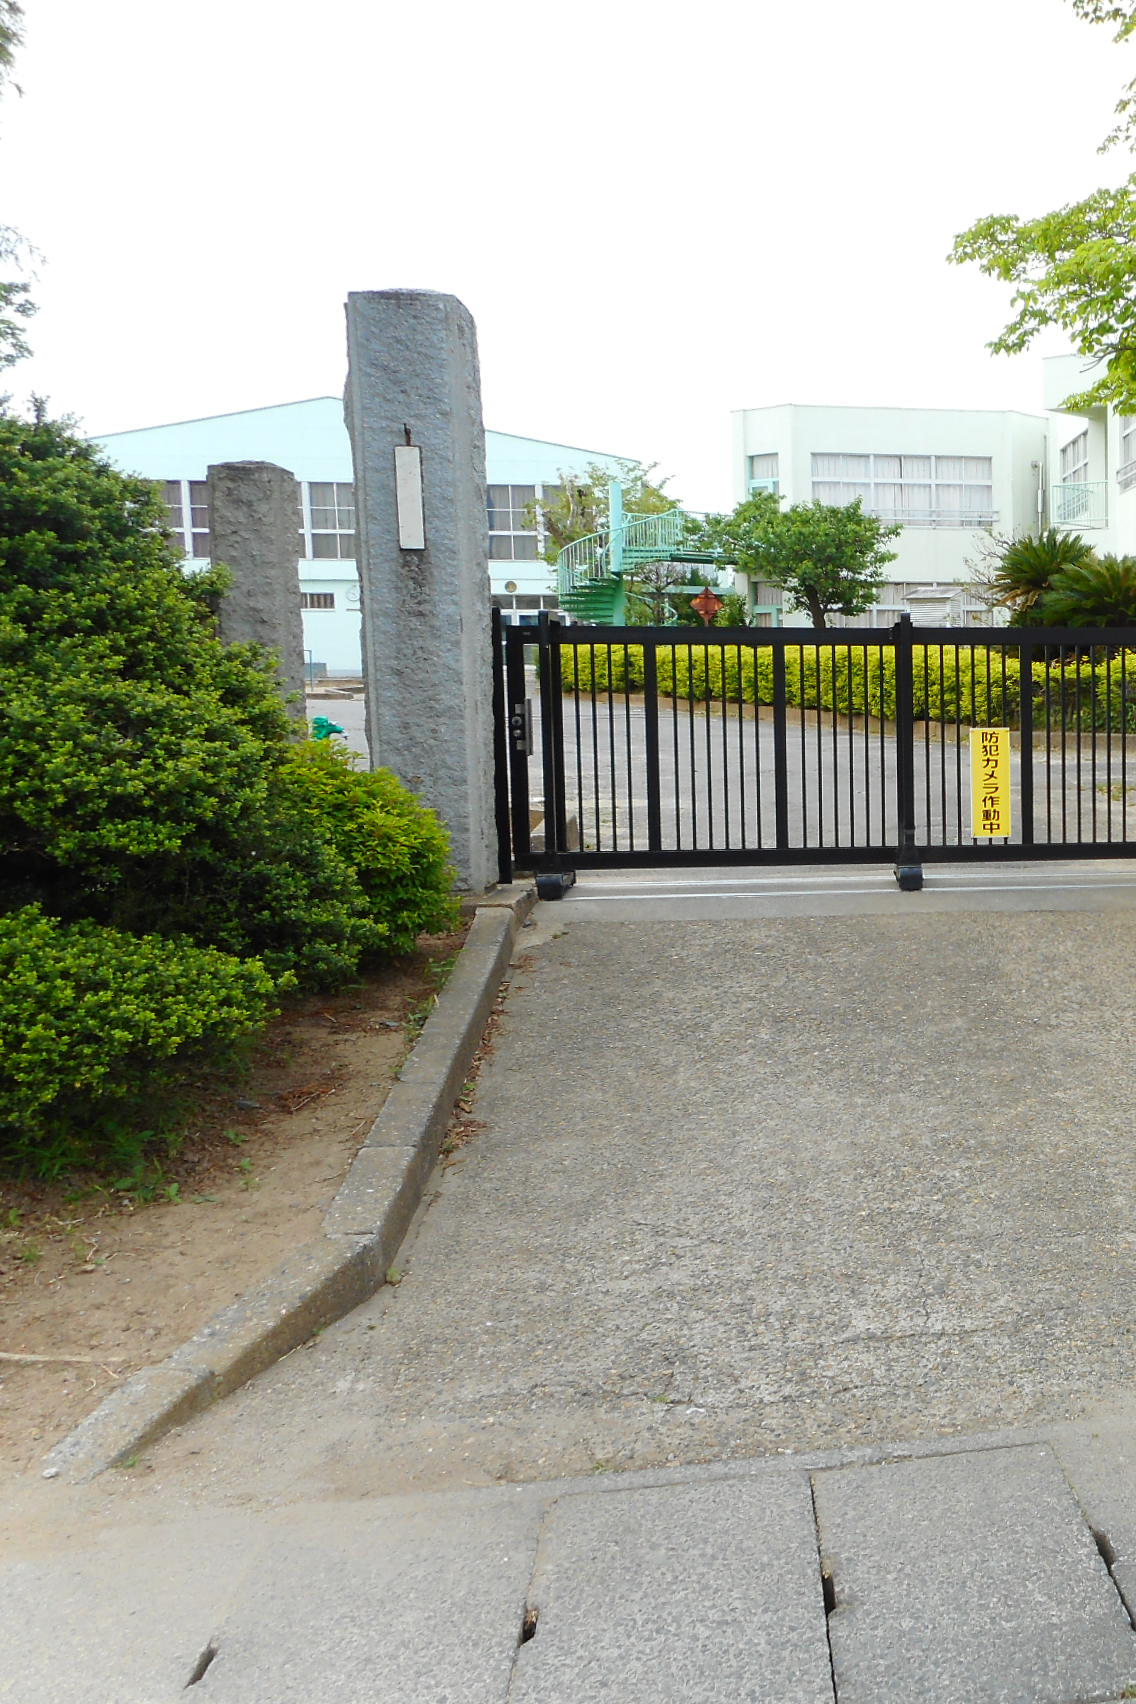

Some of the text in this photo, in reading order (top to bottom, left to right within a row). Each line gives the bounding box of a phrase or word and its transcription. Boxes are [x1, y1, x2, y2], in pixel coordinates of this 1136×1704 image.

[981, 731, 1000, 834] 防犯カメラ作動中
